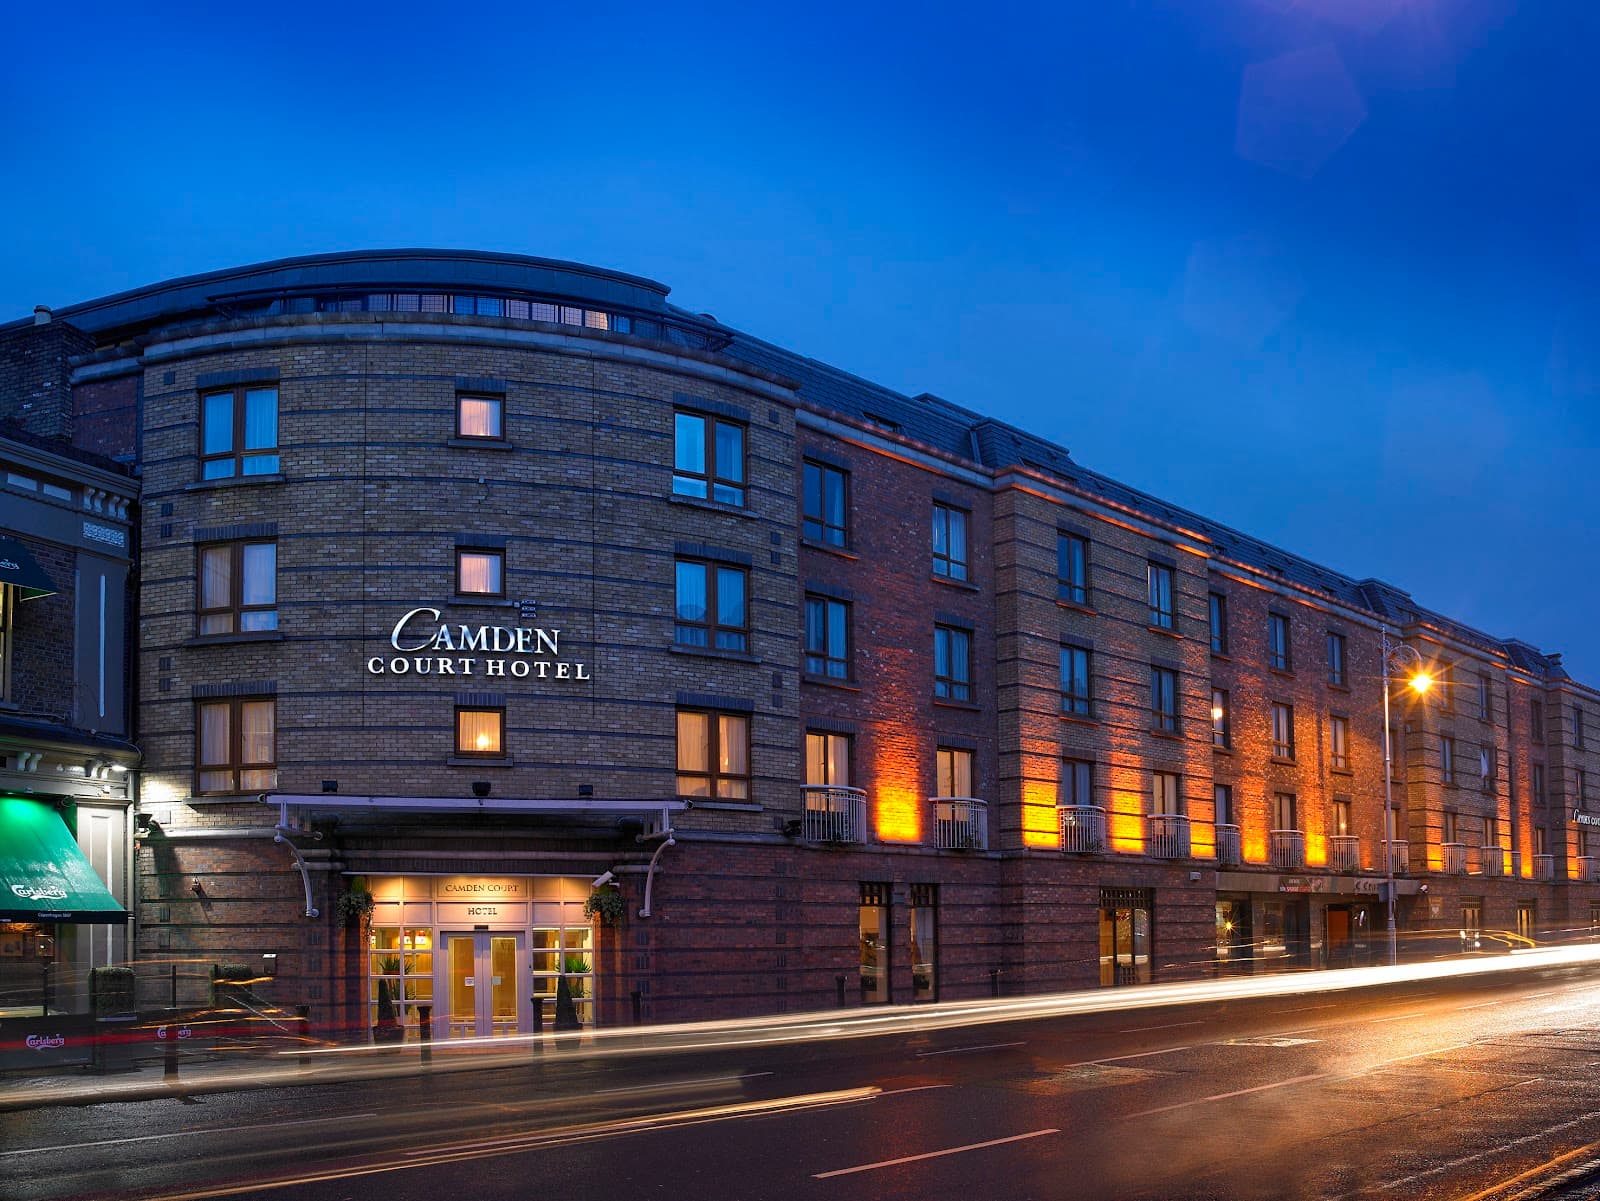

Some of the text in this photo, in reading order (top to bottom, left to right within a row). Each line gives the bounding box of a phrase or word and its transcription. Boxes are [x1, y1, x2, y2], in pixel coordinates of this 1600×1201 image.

[391, 607, 561, 656] CAMDEN
[367, 657, 590, 680] COURT HOTEL
[11, 884, 67, 900] Carlsberg
[445, 884, 519, 892] CAMDEN COURT
[467, 907, 498, 916] HOTEL
[157, 1026, 192, 1039] Caerg
[25, 1033, 65, 1050] Carlsberg
